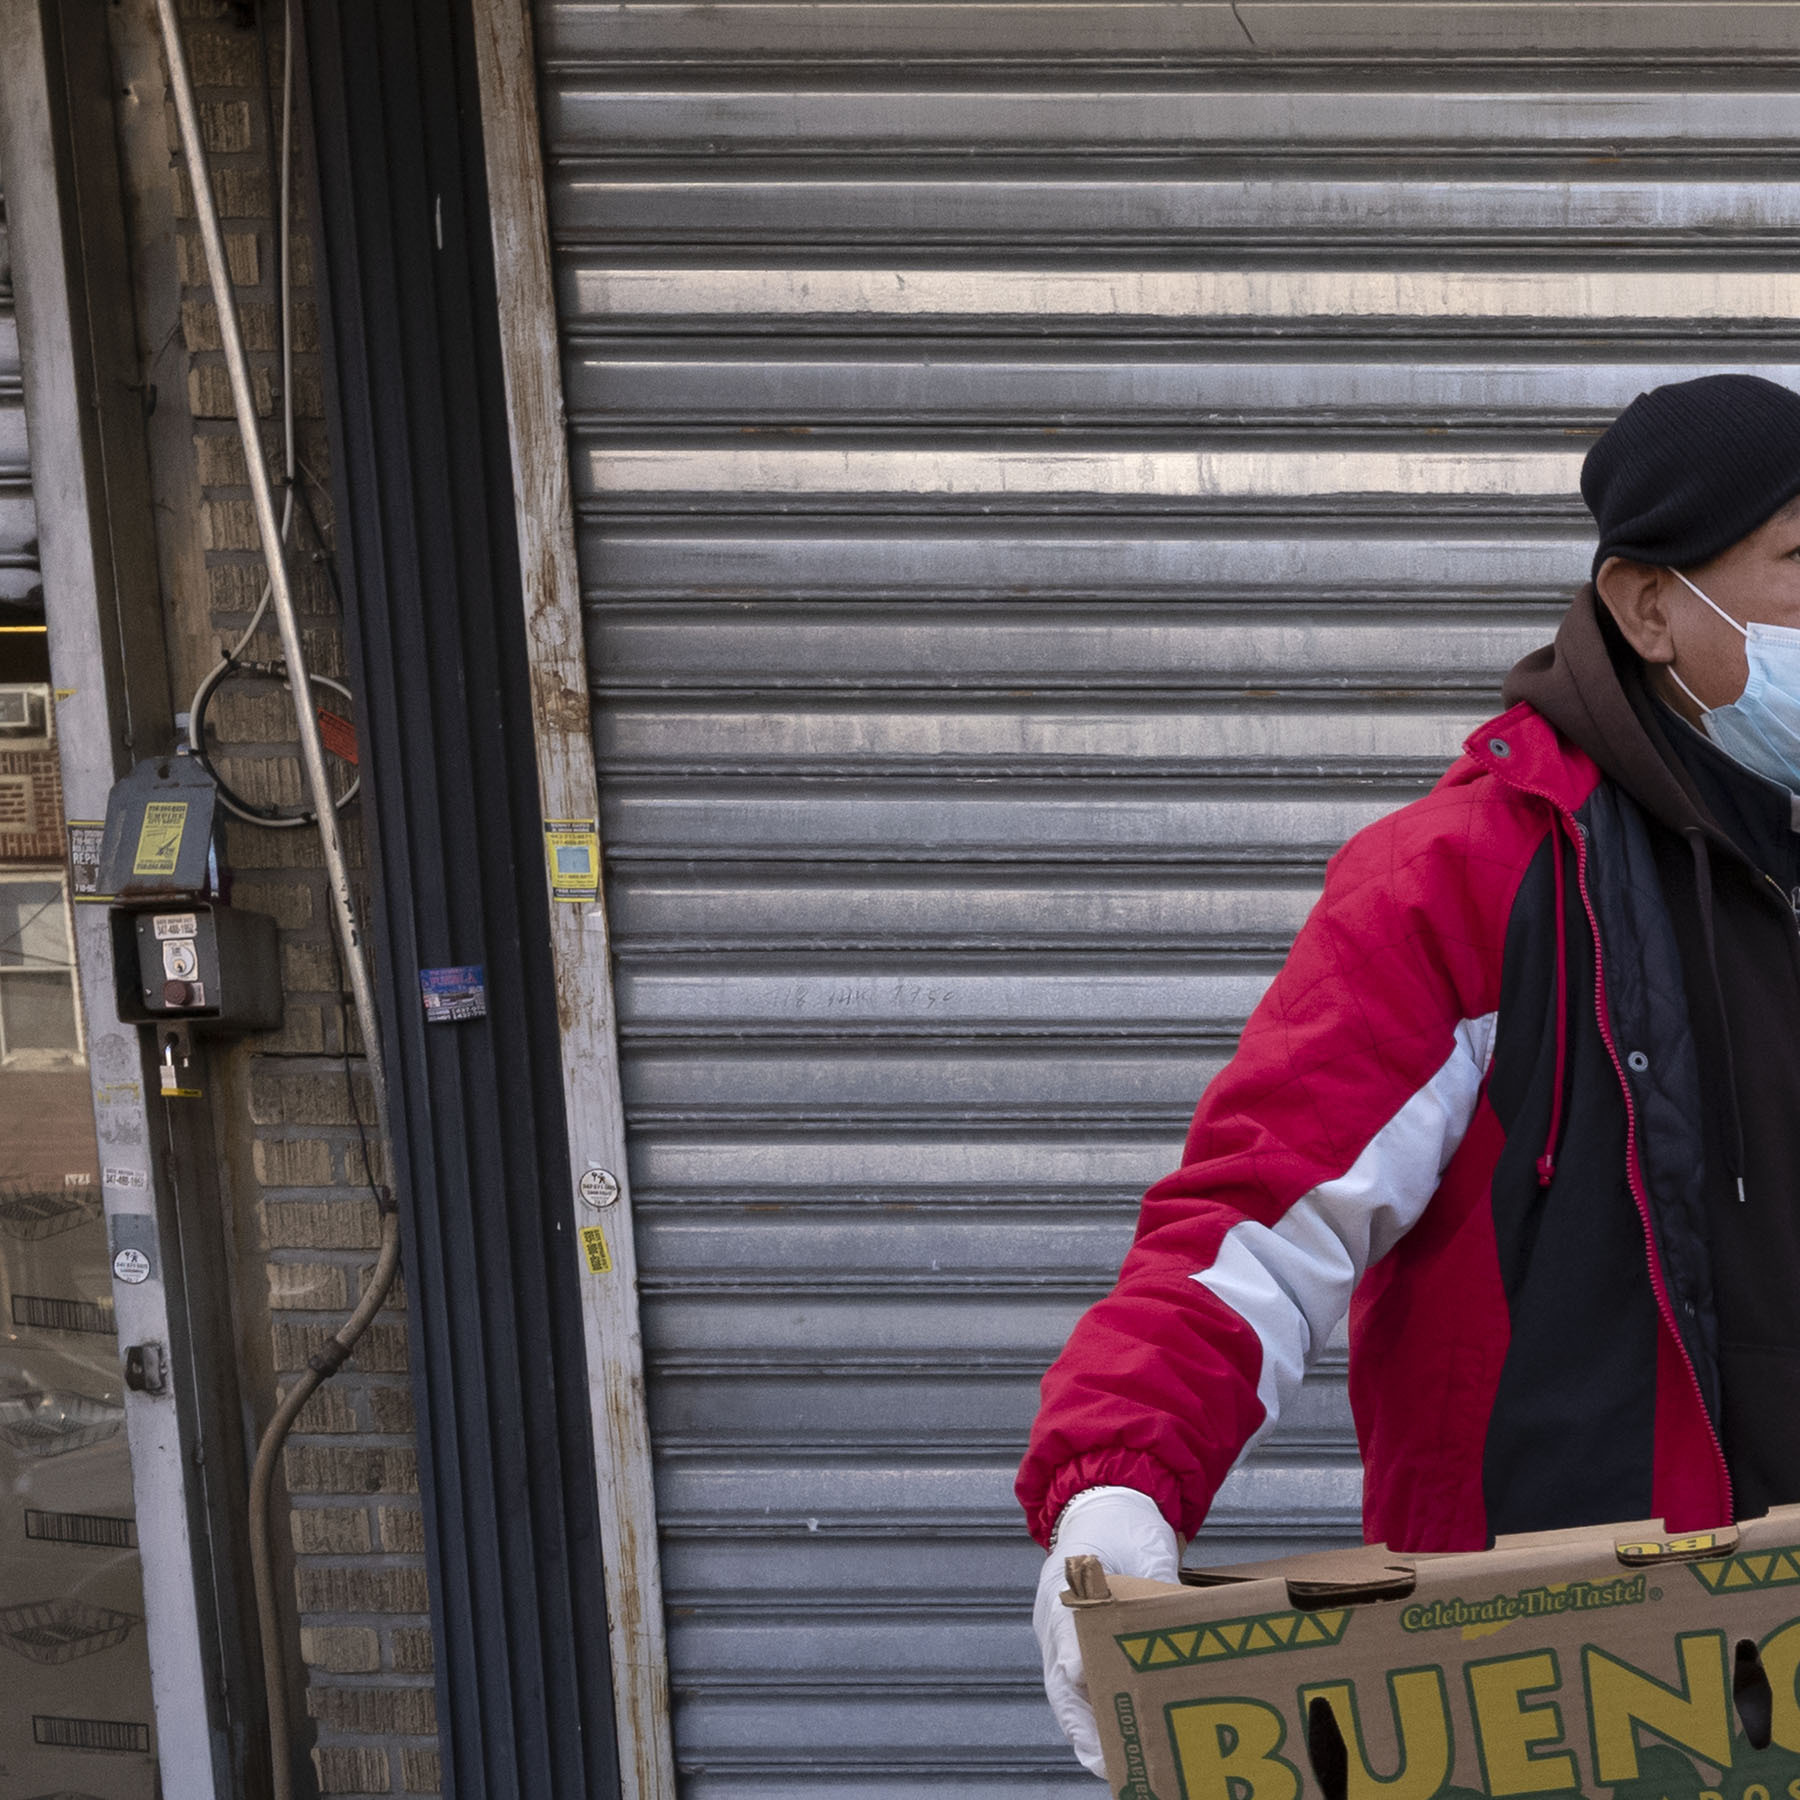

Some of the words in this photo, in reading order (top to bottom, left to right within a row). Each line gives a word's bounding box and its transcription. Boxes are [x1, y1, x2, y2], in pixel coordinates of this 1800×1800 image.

[72, 852, 100, 865] REPAI
[1403, 1596, 1520, 1630] Celebrate
[1526, 1589, 1568, 1614] The
[1570, 1579, 1644, 1607] Taste!
